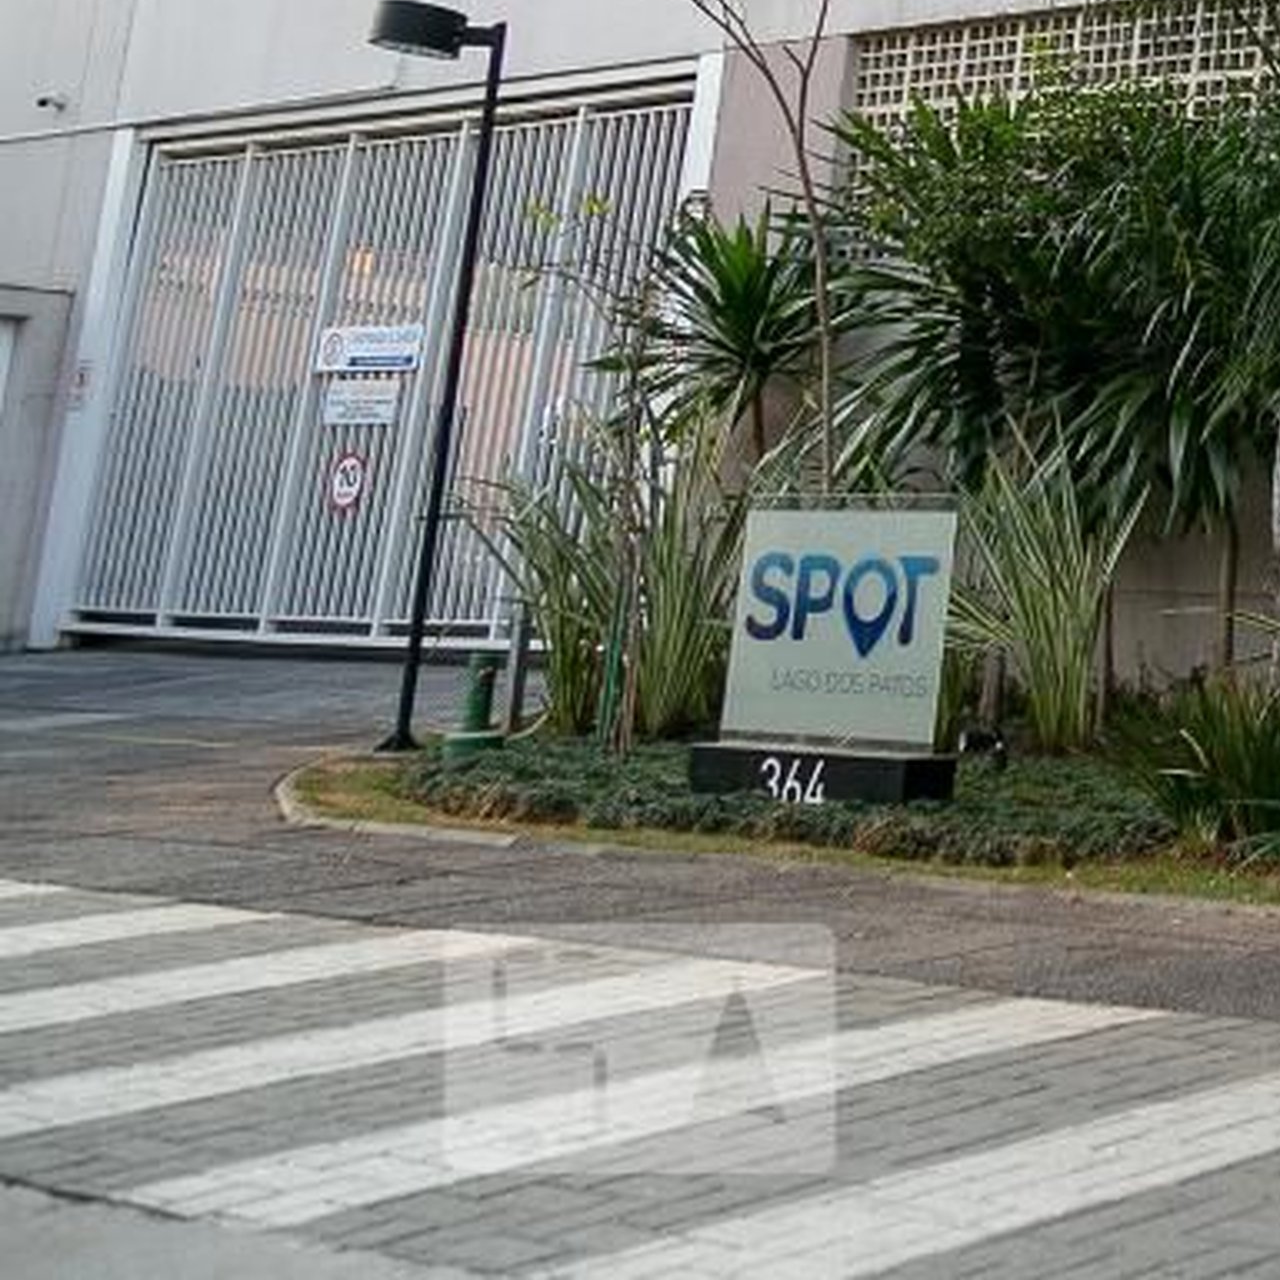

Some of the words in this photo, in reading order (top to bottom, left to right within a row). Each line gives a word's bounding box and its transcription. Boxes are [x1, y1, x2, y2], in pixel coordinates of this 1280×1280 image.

[745, 551, 940, 658] SPOT
[772, 669, 821, 694] LAGO
[825, 671, 864, 695] DOS
[869, 673, 929, 698] PATOS
[761, 757, 826, 805] 364
